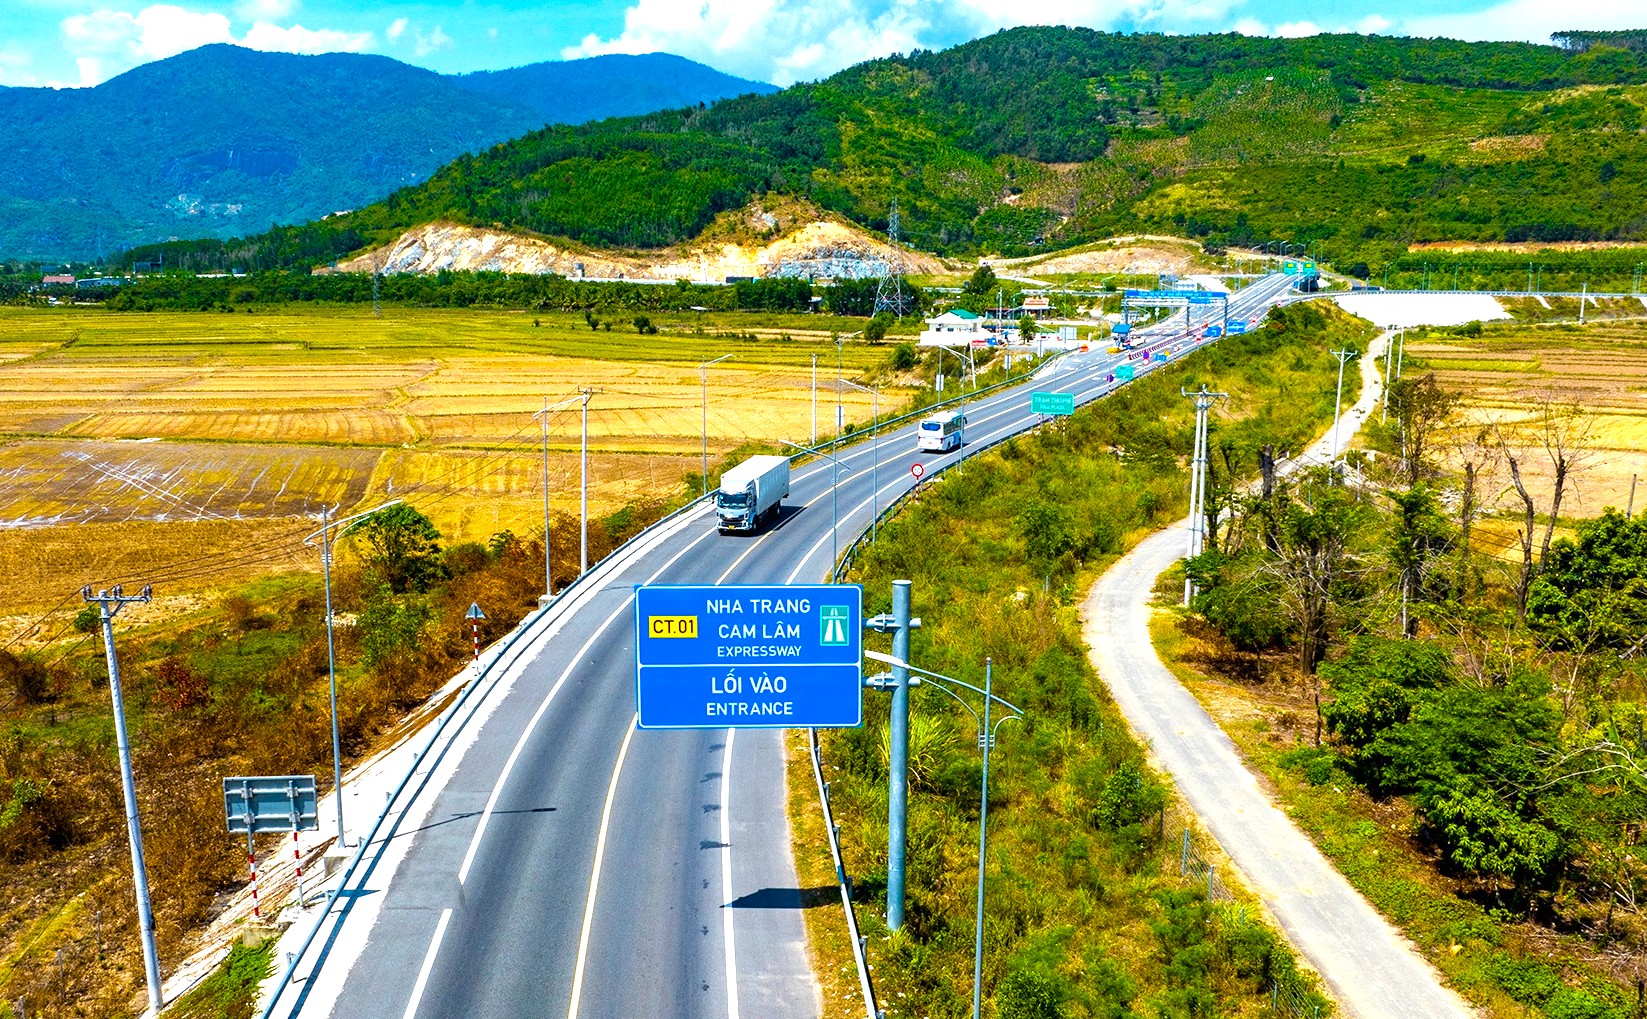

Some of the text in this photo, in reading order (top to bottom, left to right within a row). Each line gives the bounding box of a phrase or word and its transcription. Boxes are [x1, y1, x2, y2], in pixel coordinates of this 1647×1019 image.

[706, 598, 811, 614] NHA TRANG
[652, 619, 695, 634] CT.01
[718, 621, 800, 639] CAM LÂM
[717, 645, 802, 657] EXPRESSWAY
[711, 668, 787, 694] LỐI VÀO
[706, 701, 793, 716] ENTRANCE
